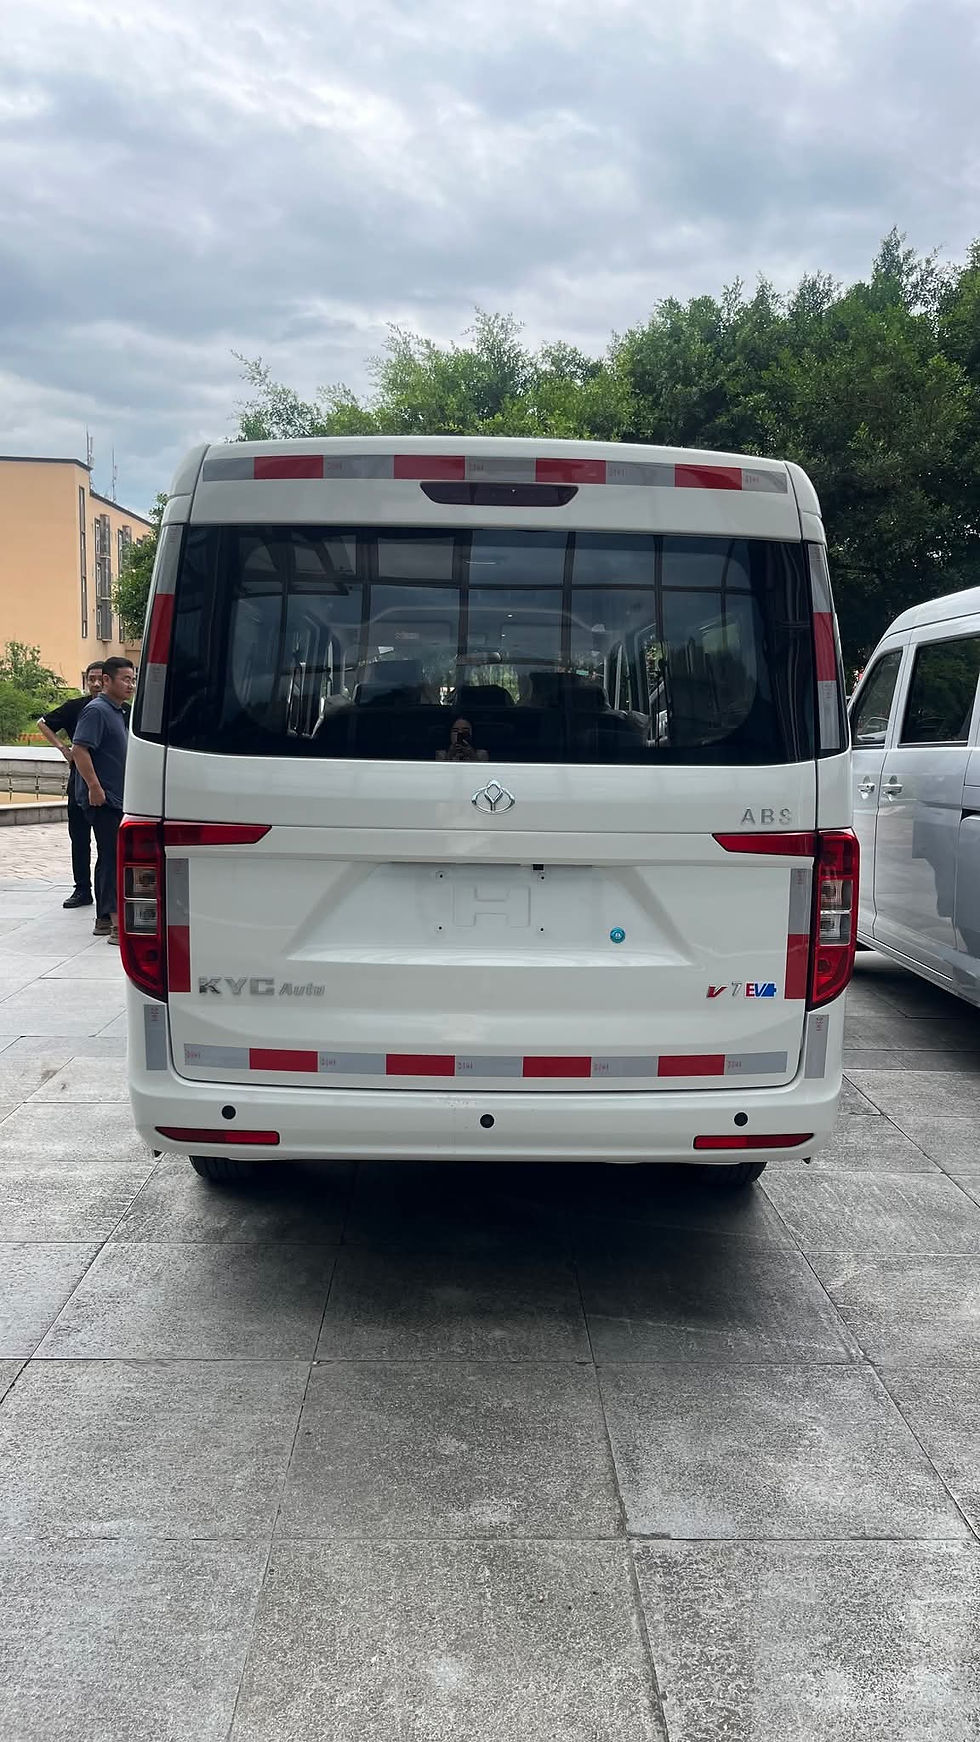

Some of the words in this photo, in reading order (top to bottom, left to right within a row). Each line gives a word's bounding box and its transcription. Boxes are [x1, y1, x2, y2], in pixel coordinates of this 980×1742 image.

[741, 808, 792, 825] ABS
[199, 976, 274, 996] KYC
[279, 983, 325, 996] Auto
